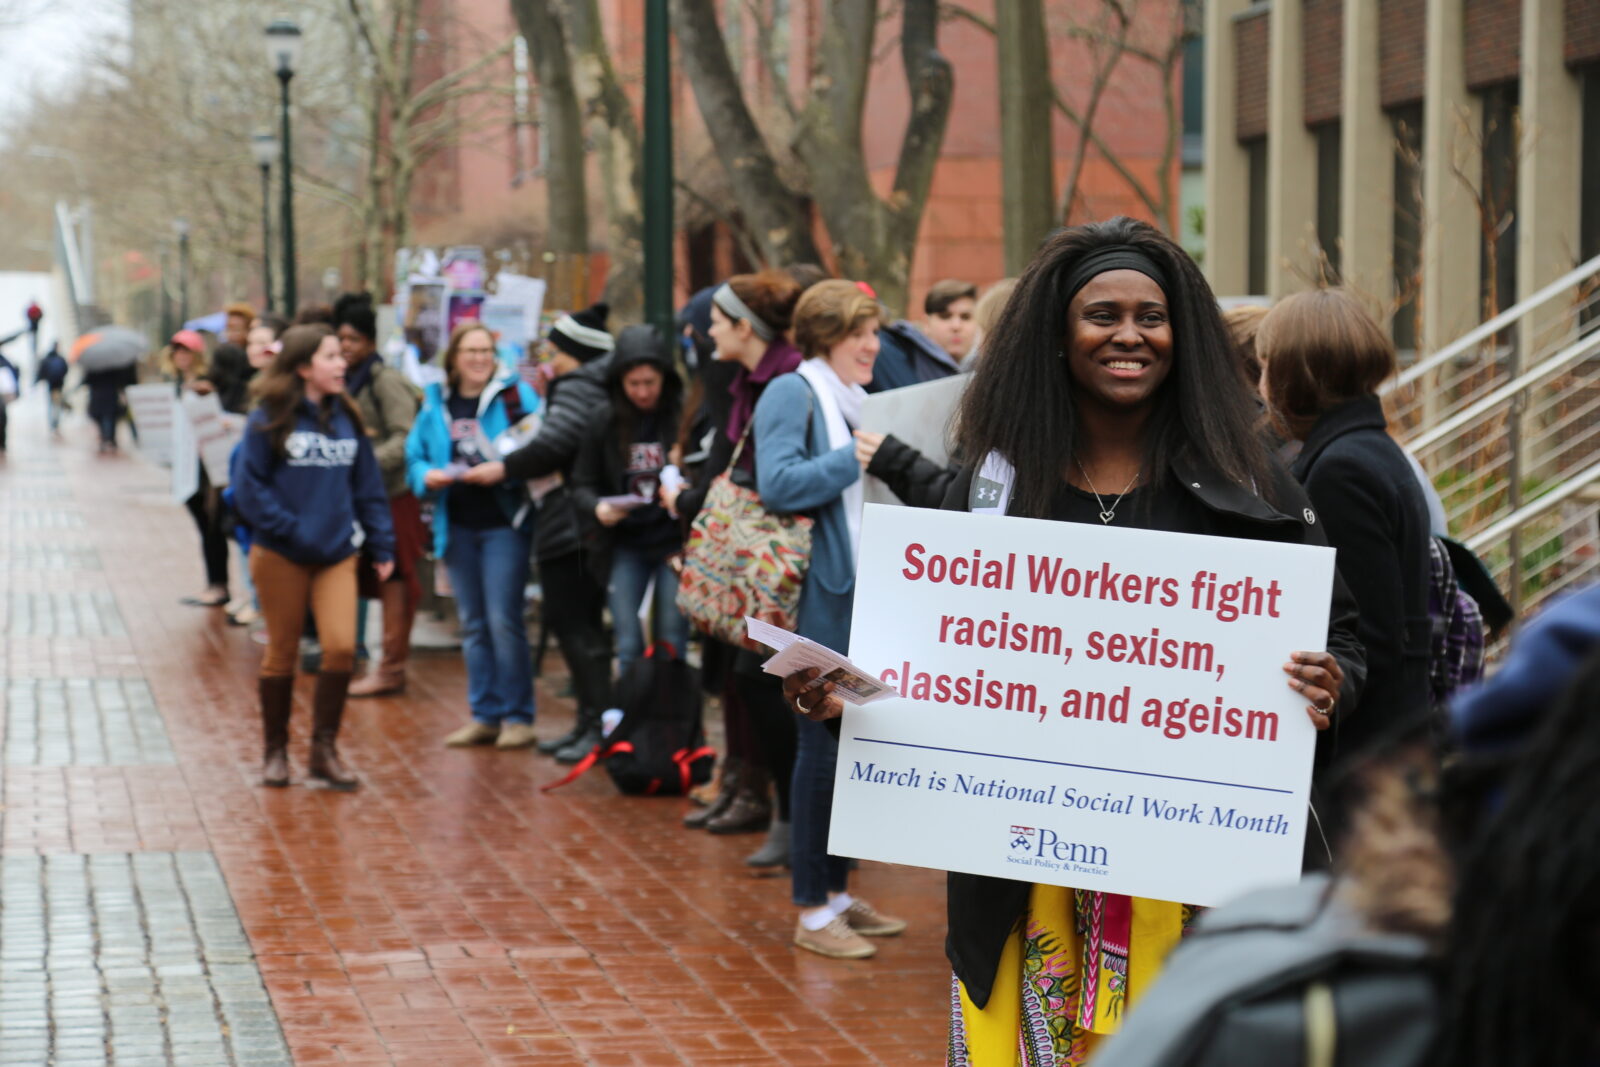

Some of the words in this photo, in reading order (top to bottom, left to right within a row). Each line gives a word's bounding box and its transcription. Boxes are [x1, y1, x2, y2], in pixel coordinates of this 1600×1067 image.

[902, 543, 1016, 590] Social
[1027, 554, 1179, 607] Workers
[1191, 570, 1282, 623] fight
[939, 611, 1074, 664] racism,
[1086, 627, 1226, 681] sexism,
[1061, 686, 1131, 724] and
[1141, 696, 1279, 742] ageism
[849, 761, 921, 788] March
[927, 770, 947, 791] is
[952, 773, 1057, 805] National
[1061, 787, 1135, 815] Social
[1142, 797, 1204, 824] Work
[1208, 806, 1289, 836] Month
[1006, 855, 1032, 866] Social
[1034, 858, 1060, 871] Policy
[1063, 863, 1070, 871] &
[1073, 864, 1109, 876] Practice
[1035, 828, 1109, 867] Penn
